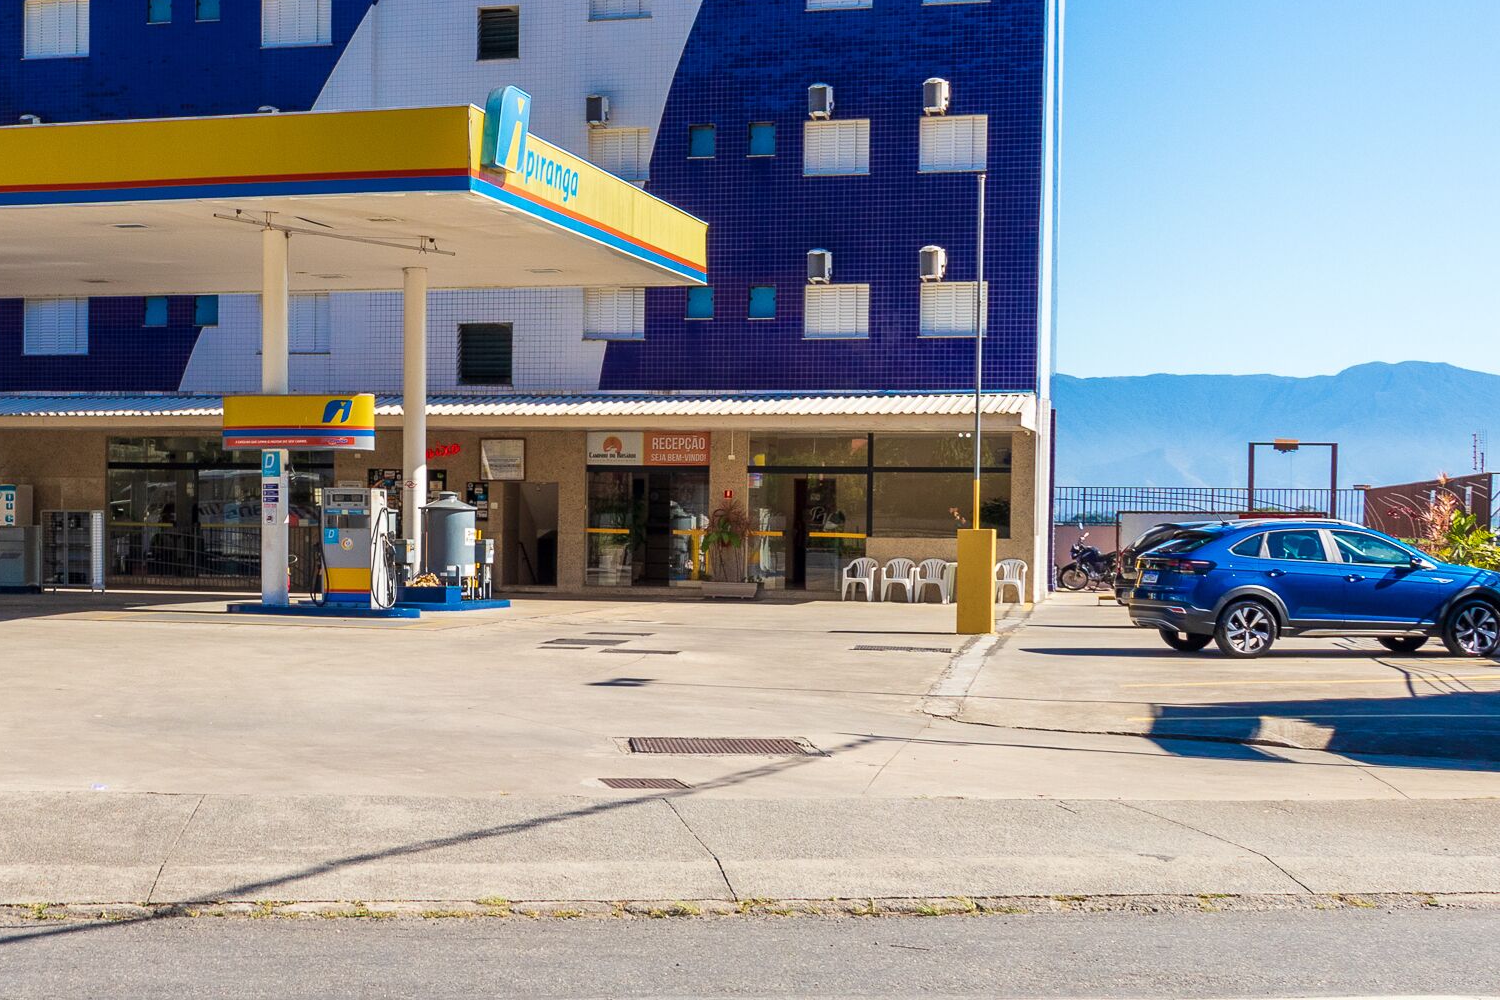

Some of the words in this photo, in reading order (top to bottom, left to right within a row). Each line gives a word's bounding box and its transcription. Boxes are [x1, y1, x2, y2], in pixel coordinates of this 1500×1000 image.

[521, 149, 579, 202] piranga
[651, 434, 706, 453] RECEPÇÃO
[651, 453, 667, 462] SEJA
